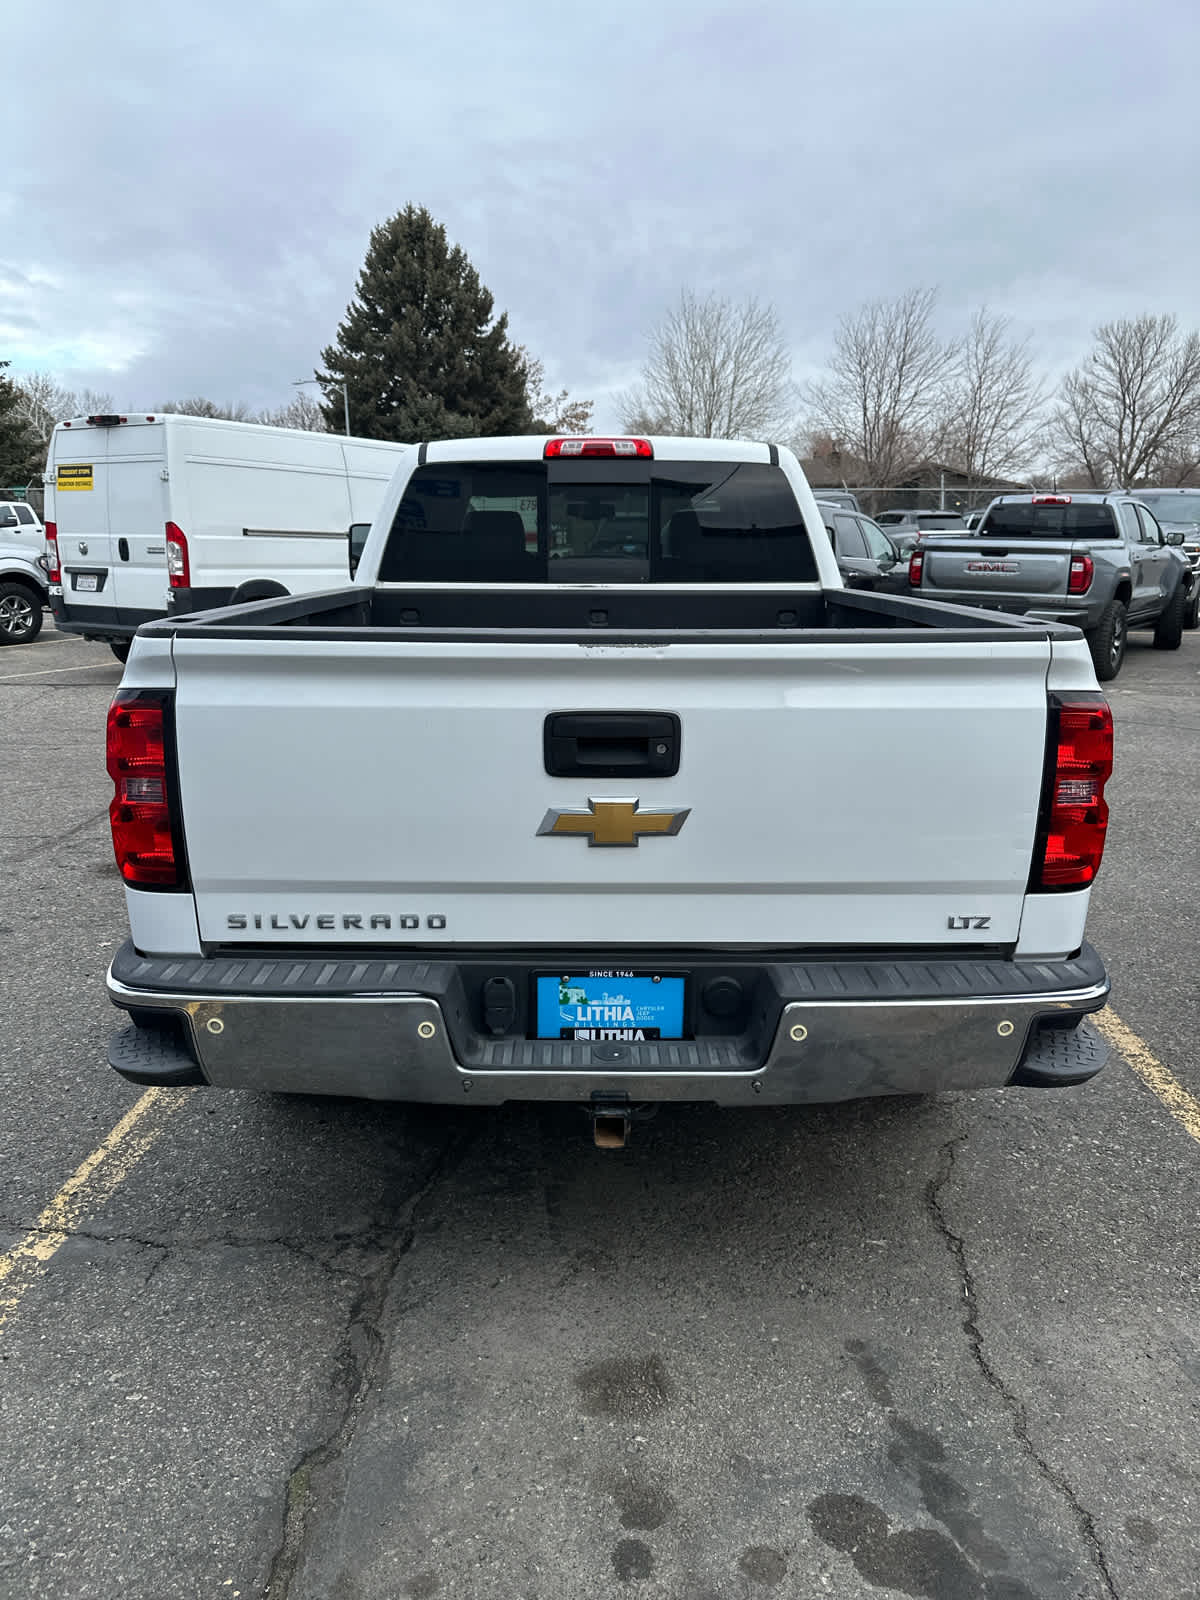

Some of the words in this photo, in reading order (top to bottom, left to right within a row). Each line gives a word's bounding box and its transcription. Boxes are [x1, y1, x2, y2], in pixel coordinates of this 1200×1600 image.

[967, 562, 1018, 573] GMC
[227, 914, 447, 930] SILVERADO
[947, 915, 991, 930] LTZ
[577, 1006, 635, 1022] LITHIA
[591, 1029, 646, 1041] LITHIA
